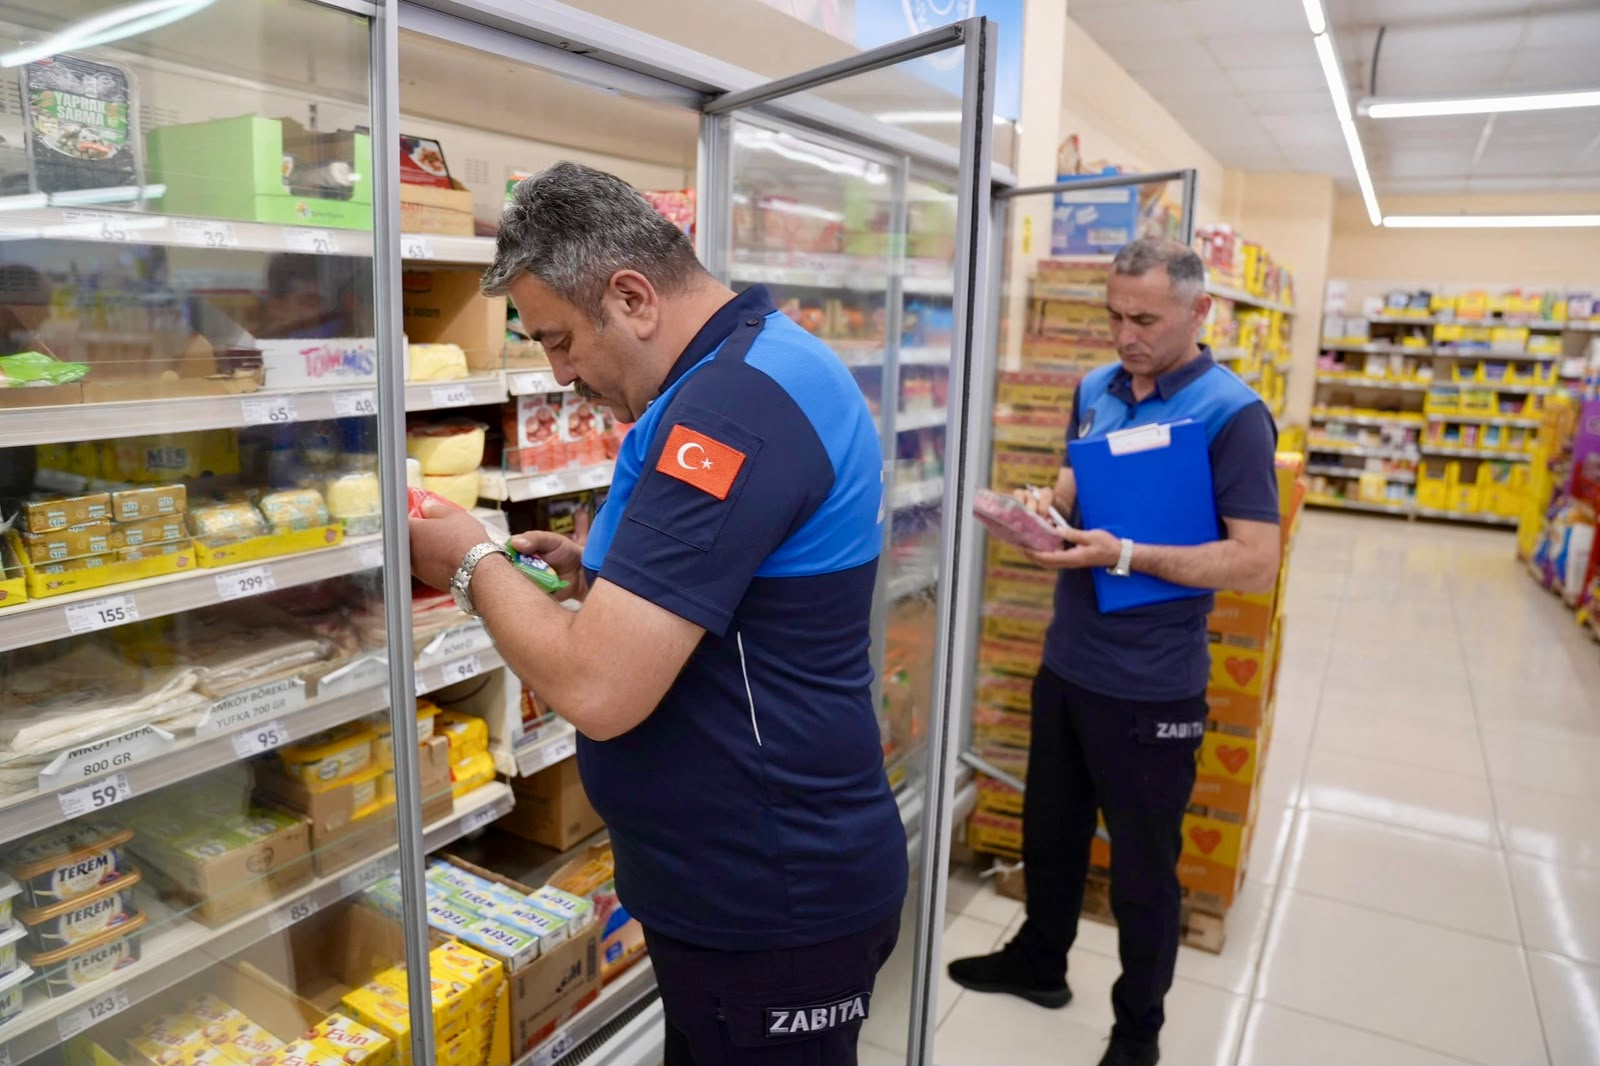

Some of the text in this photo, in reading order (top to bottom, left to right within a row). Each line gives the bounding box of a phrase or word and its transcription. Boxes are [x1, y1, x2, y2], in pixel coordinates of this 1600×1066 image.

[57, 106, 105, 126] SARMA
[203, 231, 228, 247] 32
[269, 407, 288, 422] 65
[355, 400, 374, 413] 48
[238, 576, 262, 591] 299
[97, 607, 125, 623] 155
[216, 699, 286, 728] YUFKA 700 GR
[257, 729, 278, 747] 95
[83, 752, 132, 776] 800 GR
[91, 785, 116, 807] 59
[58, 855, 108, 882] TEREM
[65, 897, 115, 925] TEREM
[291, 902, 309, 920] 85
[88, 998, 115, 1019] 123
[769, 997, 865, 1033] ZABITA
[323, 1028, 368, 1045] Evin
